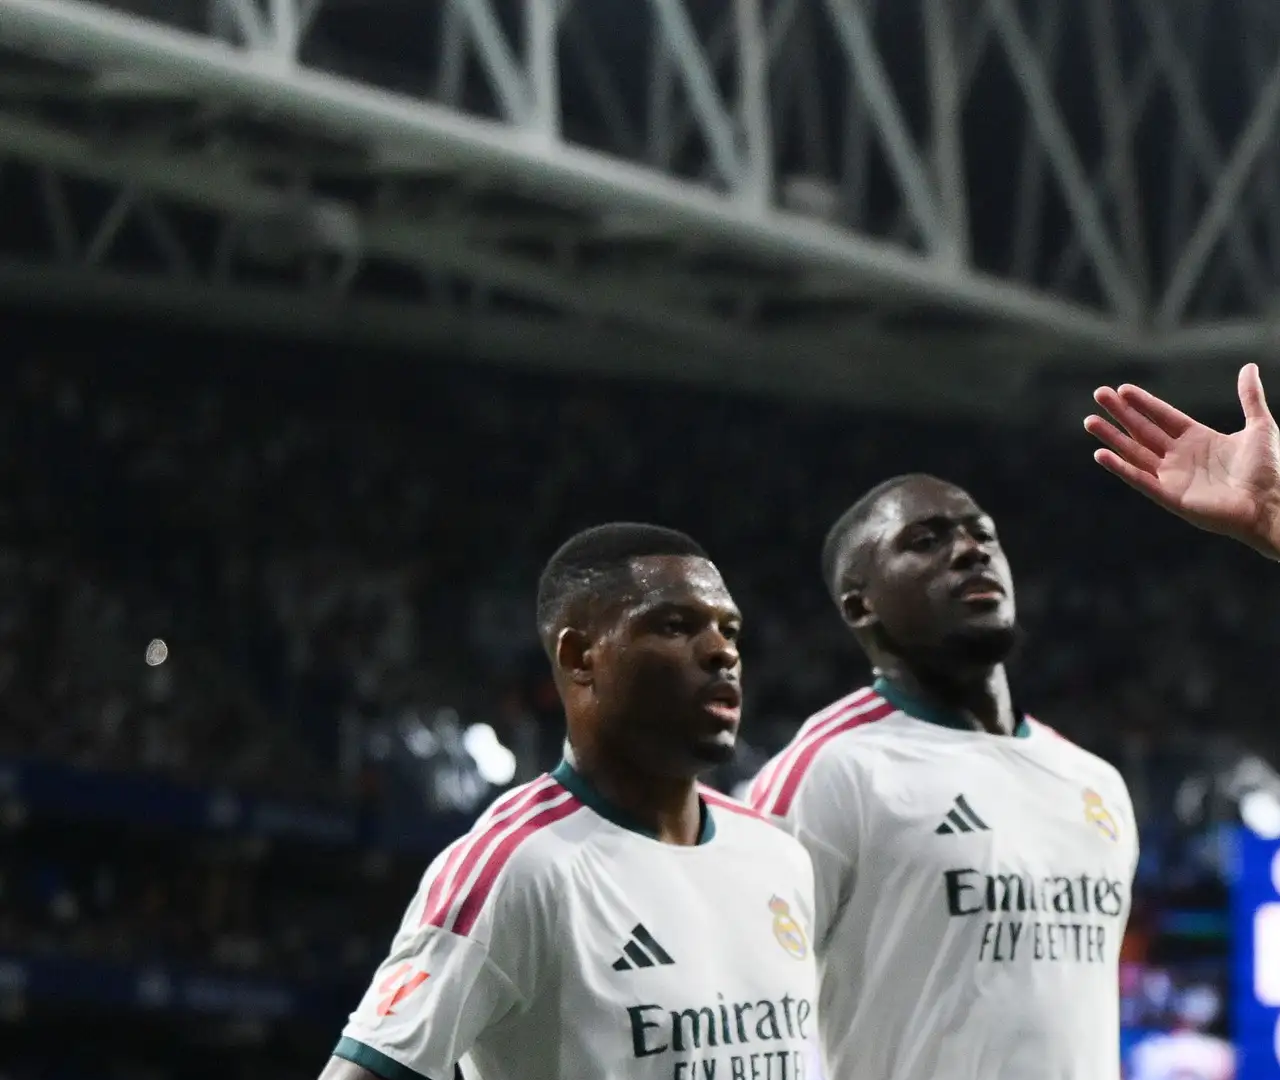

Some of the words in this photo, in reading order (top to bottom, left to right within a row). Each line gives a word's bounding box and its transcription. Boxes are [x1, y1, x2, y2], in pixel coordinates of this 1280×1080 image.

[944, 867, 1124, 917] Emirates
[978, 921, 1023, 962] FLY
[1033, 922, 1106, 963] BETTER
[626, 992, 811, 1059] Emirate
